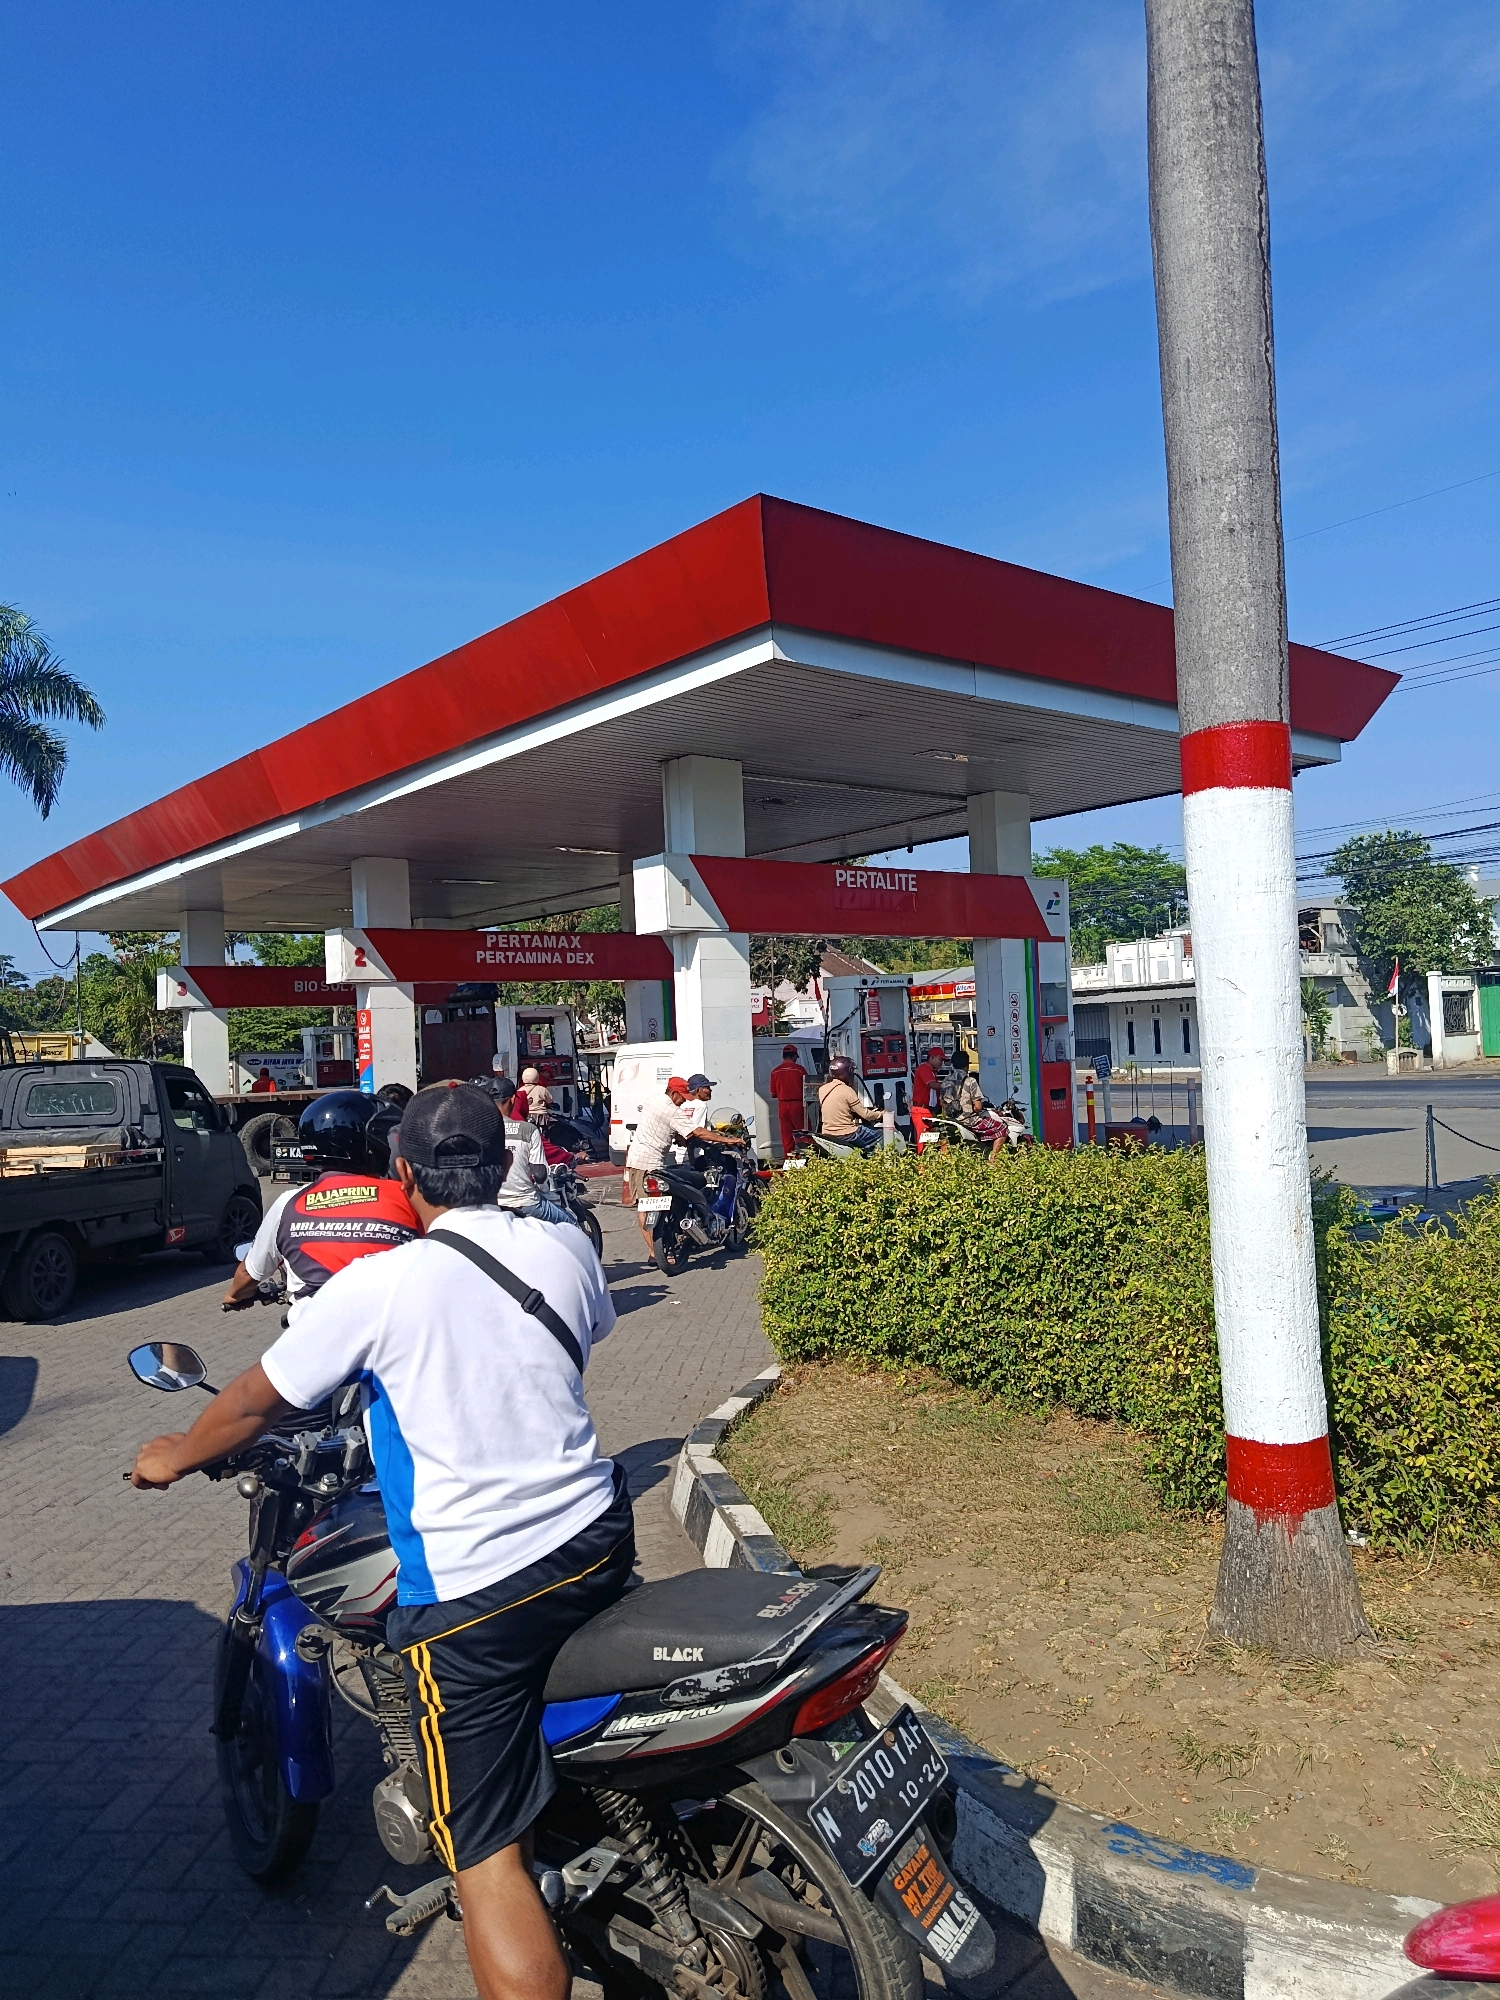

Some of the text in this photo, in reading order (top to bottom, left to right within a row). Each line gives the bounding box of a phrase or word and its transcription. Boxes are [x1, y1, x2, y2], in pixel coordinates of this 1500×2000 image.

[835, 869, 917, 892] PERTALITE
[486, 934, 581, 949] PERTAMAX
[354, 947, 367, 967] 2
[476, 951, 594, 964] PERTAMINA DEX
[177, 981, 187, 996] 3
[294, 980, 356, 992] BIO SOL
[306, 1186, 378, 1206] BAJAPRINT
[353, 1231, 392, 1240] CYCLING
[653, 1646, 704, 1662] BLACK
[611, 1700, 727, 1733] MEGAPRO
[816, 1806, 842, 1844] N
[847, 1748, 895, 1813] 2010
[901, 1880, 923, 1910] MY
[917, 1857, 938, 1889] TRIP
[949, 1900, 968, 1921] 4
[955, 1890, 974, 1912] S
[926, 1911, 960, 1956] AW
